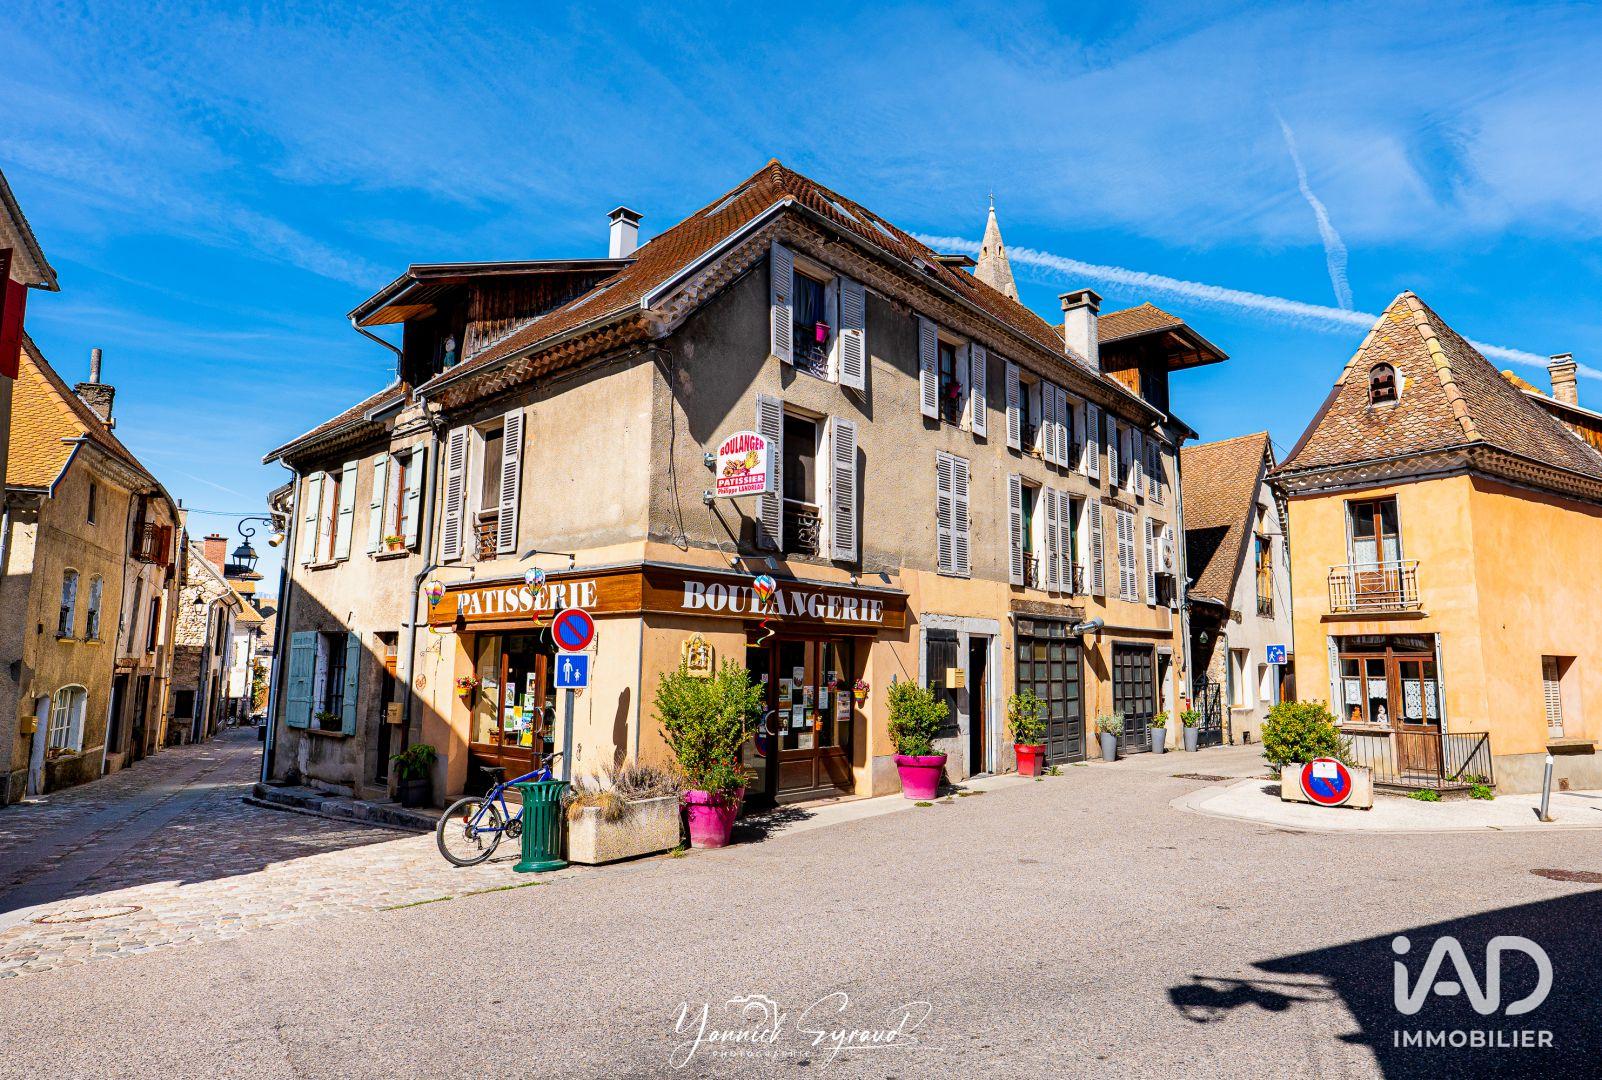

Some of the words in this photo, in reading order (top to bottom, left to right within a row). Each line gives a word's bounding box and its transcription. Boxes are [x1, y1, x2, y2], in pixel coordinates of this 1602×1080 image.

[720, 435, 764, 456] BOULANGER
[718, 475, 764, 487] PATISSIER
[457, 580, 597, 615] PATISSERIE
[681, 580, 884, 623] BOULANGERIE
